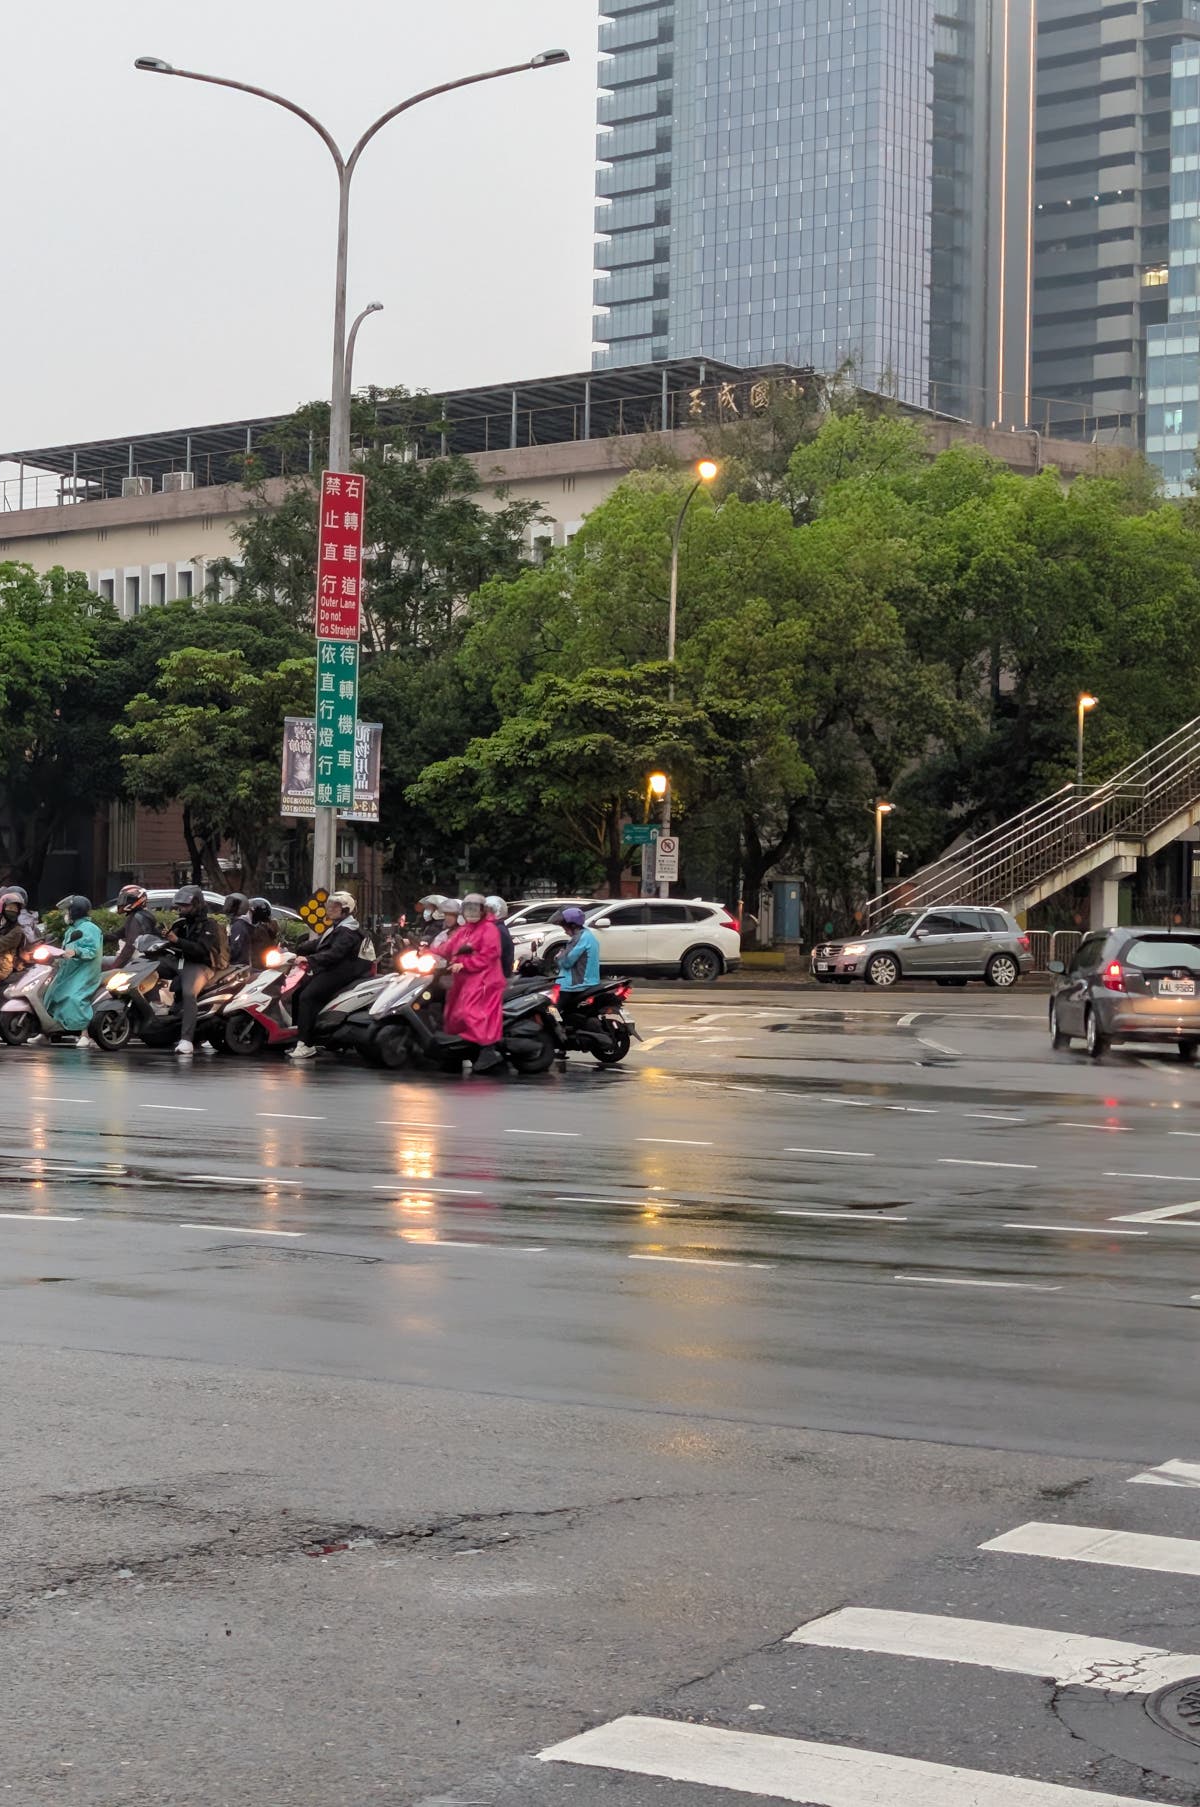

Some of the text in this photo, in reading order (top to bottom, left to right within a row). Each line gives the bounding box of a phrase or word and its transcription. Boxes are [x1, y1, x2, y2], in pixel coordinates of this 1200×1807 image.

[322, 477, 341, 594] 禁止直行
[341, 479, 360, 596] 右轉車道
[319, 623, 356, 638] Go Straight
[320, 611, 341, 622] Do not
[321, 598, 356, 609] Outer Lane
[318, 644, 336, 803] 依直行燈行駛
[336, 645, 355, 804] 待轉機車請
